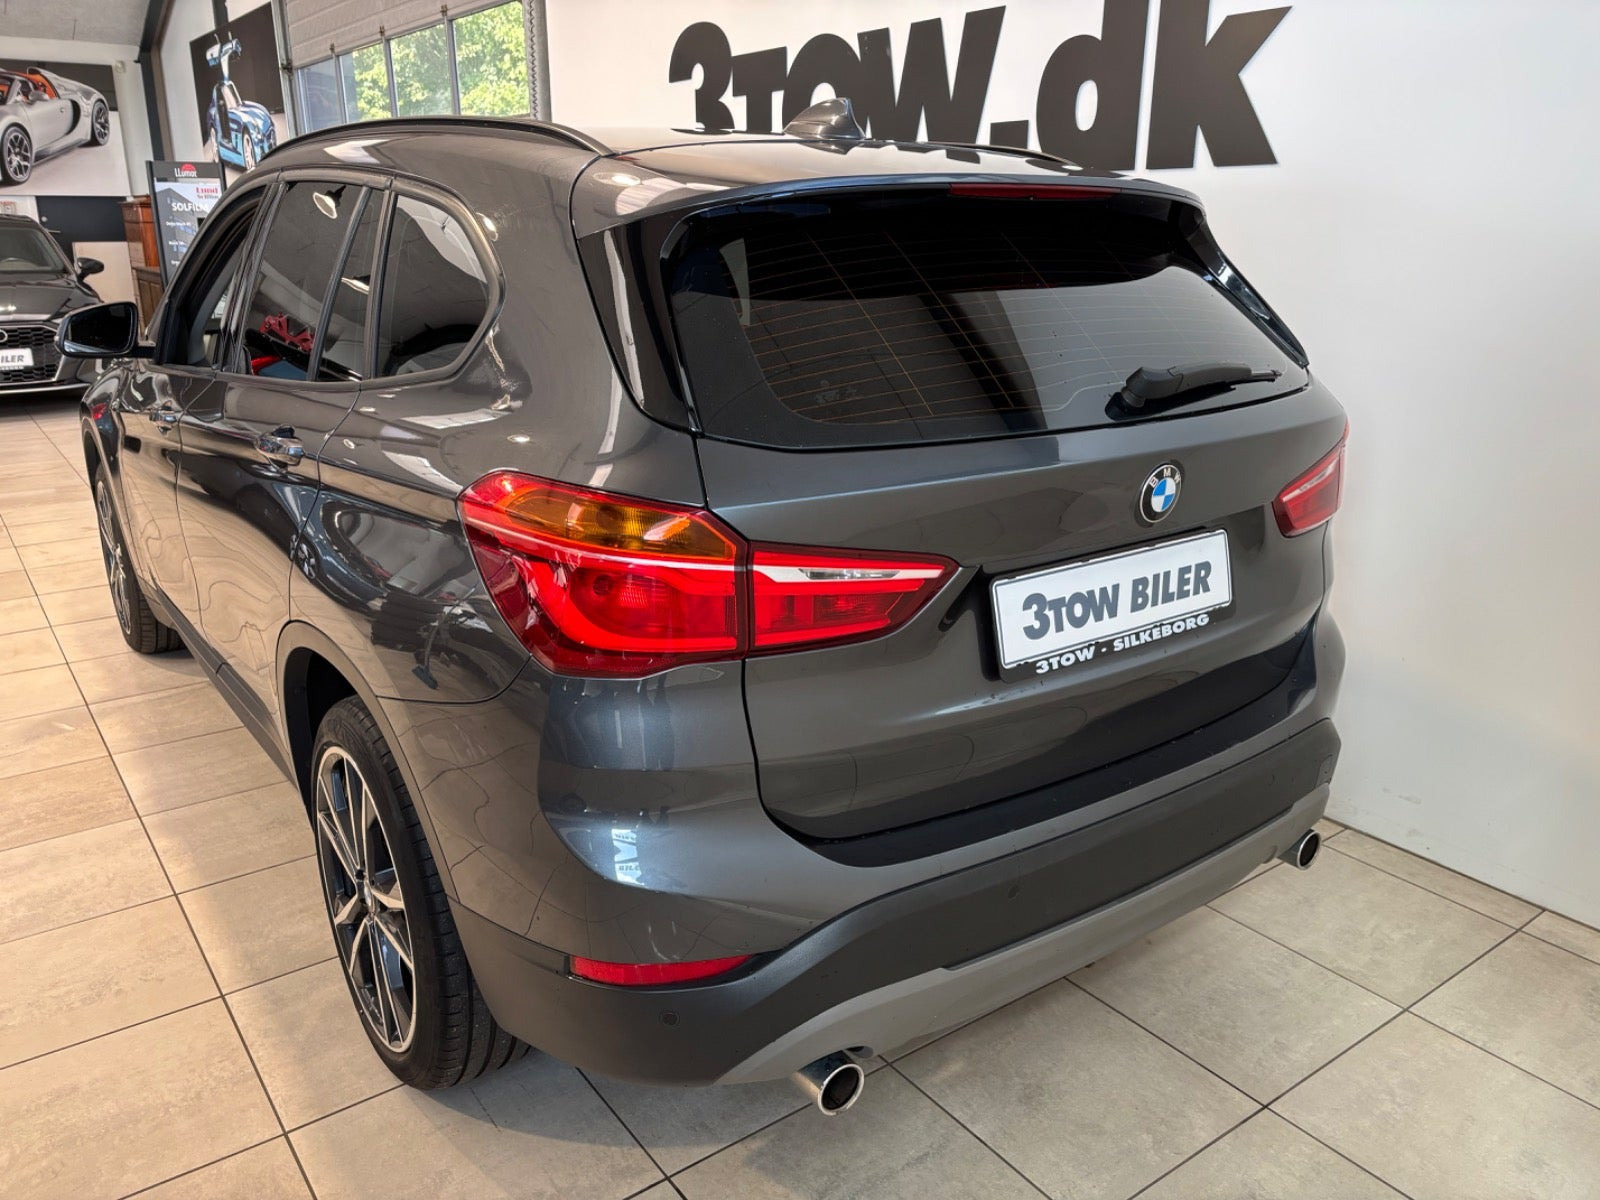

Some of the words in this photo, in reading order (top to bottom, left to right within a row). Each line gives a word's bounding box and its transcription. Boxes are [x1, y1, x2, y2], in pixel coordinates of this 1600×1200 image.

[0, 355, 25, 364] ILER
[1149, 467, 1181, 488] BMW
[1022, 582, 1120, 640] 3TOW
[1130, 560, 1212, 613] BILER
[1035, 645, 1096, 674] 3TOW
[1113, 614, 1210, 652] SILKEBORG
